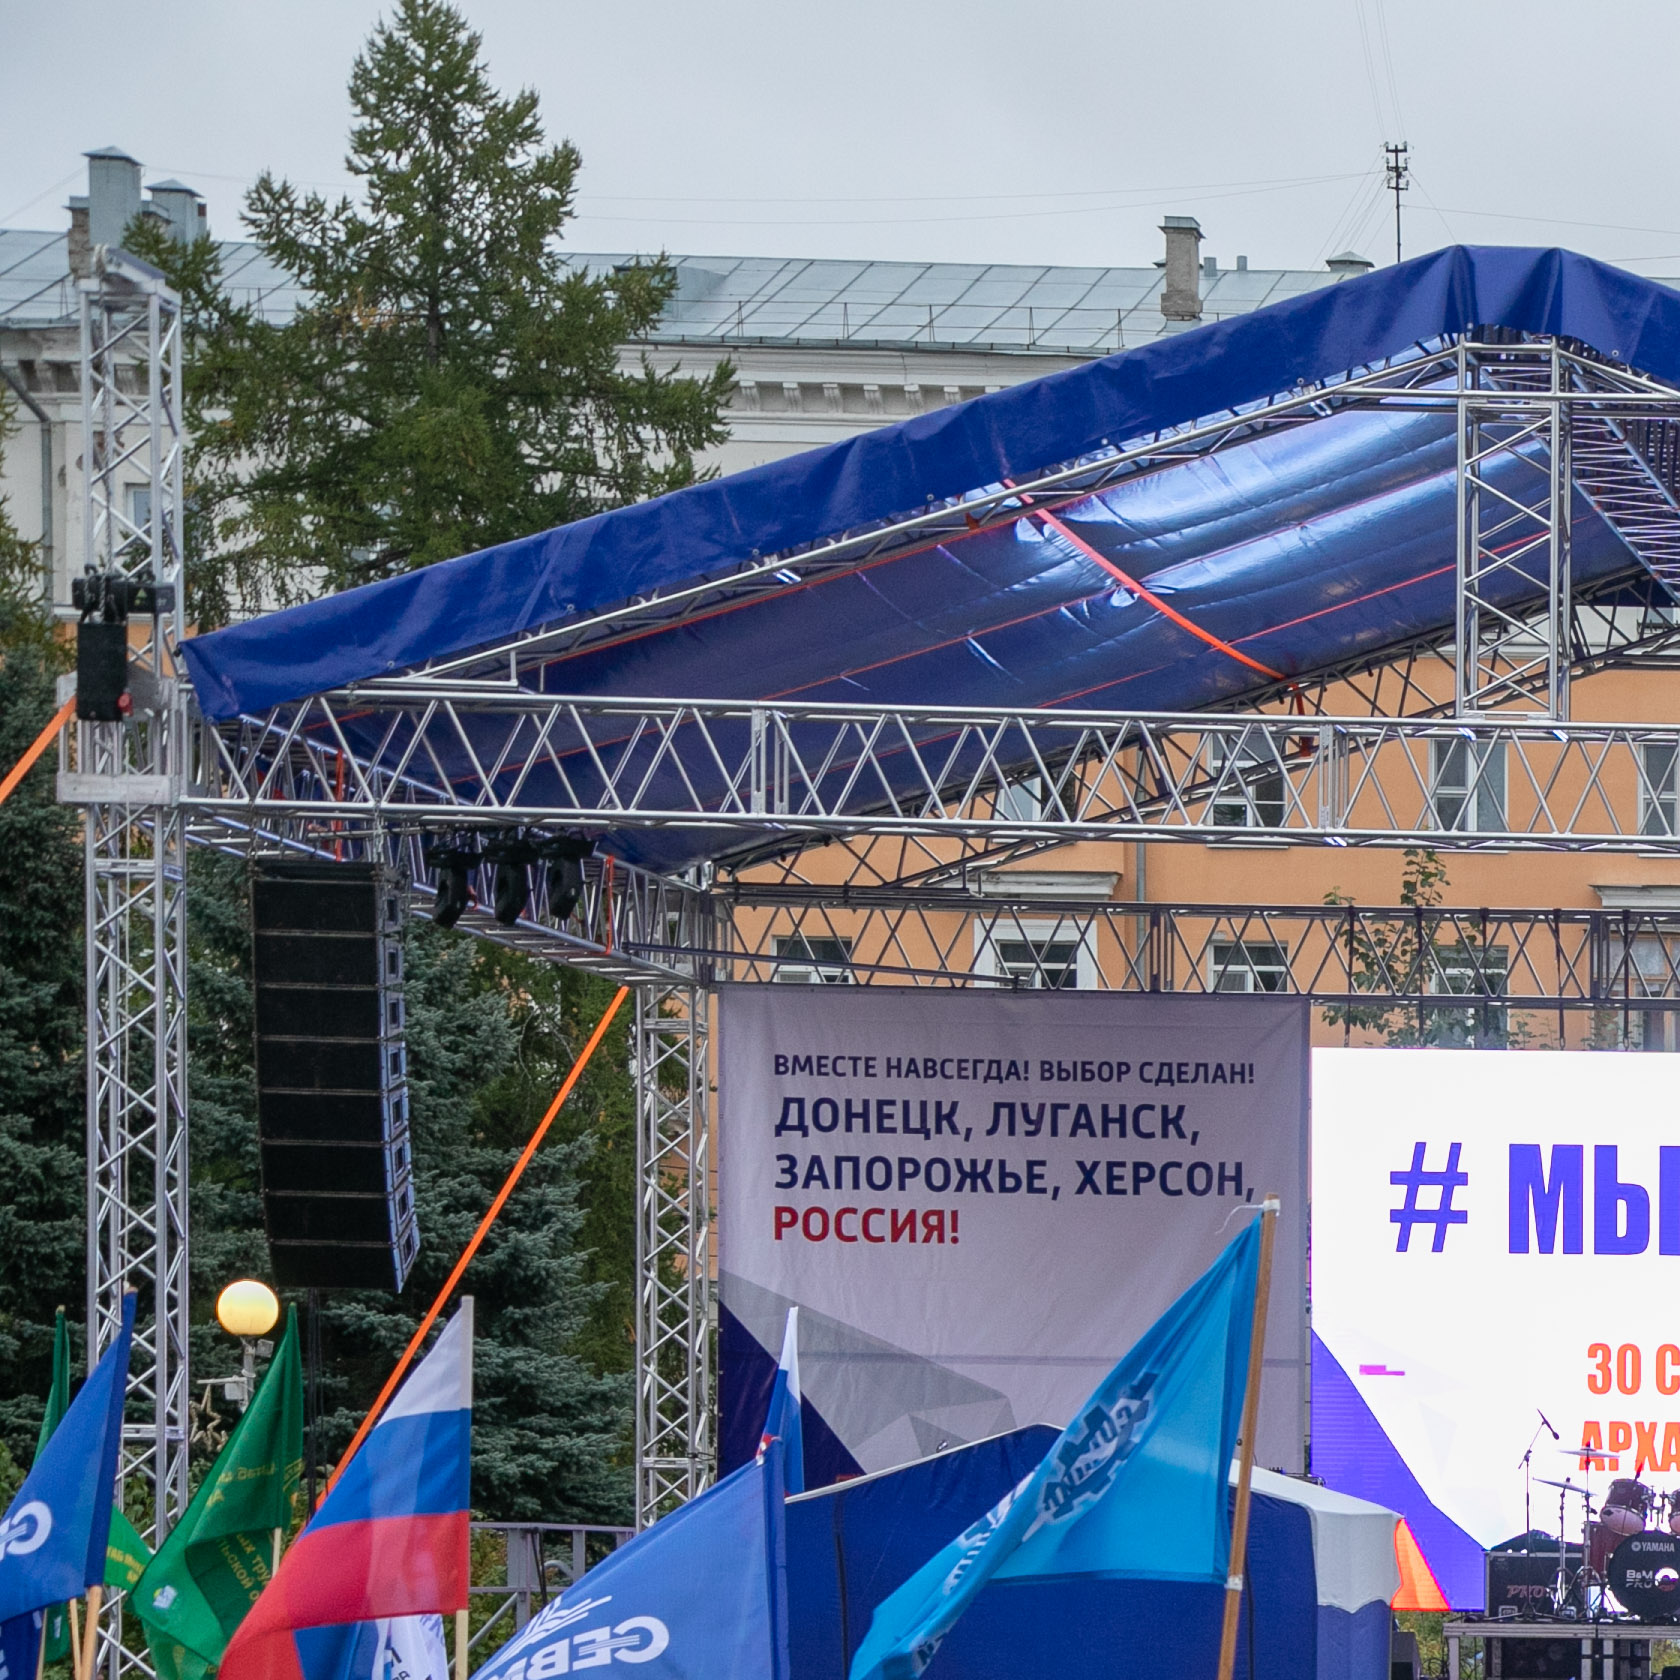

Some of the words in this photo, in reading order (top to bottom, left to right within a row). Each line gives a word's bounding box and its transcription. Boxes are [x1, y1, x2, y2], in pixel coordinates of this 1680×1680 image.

[774, 1054, 877, 1079] ВМЕСТЕ
[886, 1056, 1030, 1084] НАВСЕГДА!
[1040, 1060, 1132, 1083] ВЫБОР
[1139, 1061, 1255, 1087] СДЕЛАН!
[774, 1096, 973, 1143] ДОНЕЦК,
[985, 1101, 1200, 1146] ЛУГАНСК,
[774, 1153, 1061, 1201] ЗАПОРОЖЬЕ,
[1074, 1160, 1255, 1203] ХЕРСОН,
[1390, 1141, 1468, 1252] #
[774, 1205, 959, 1244] РОССИЯ!
[1587, 1342, 1642, 1395] 30
[1641, 1541, 1675, 1553] YAMAHA
